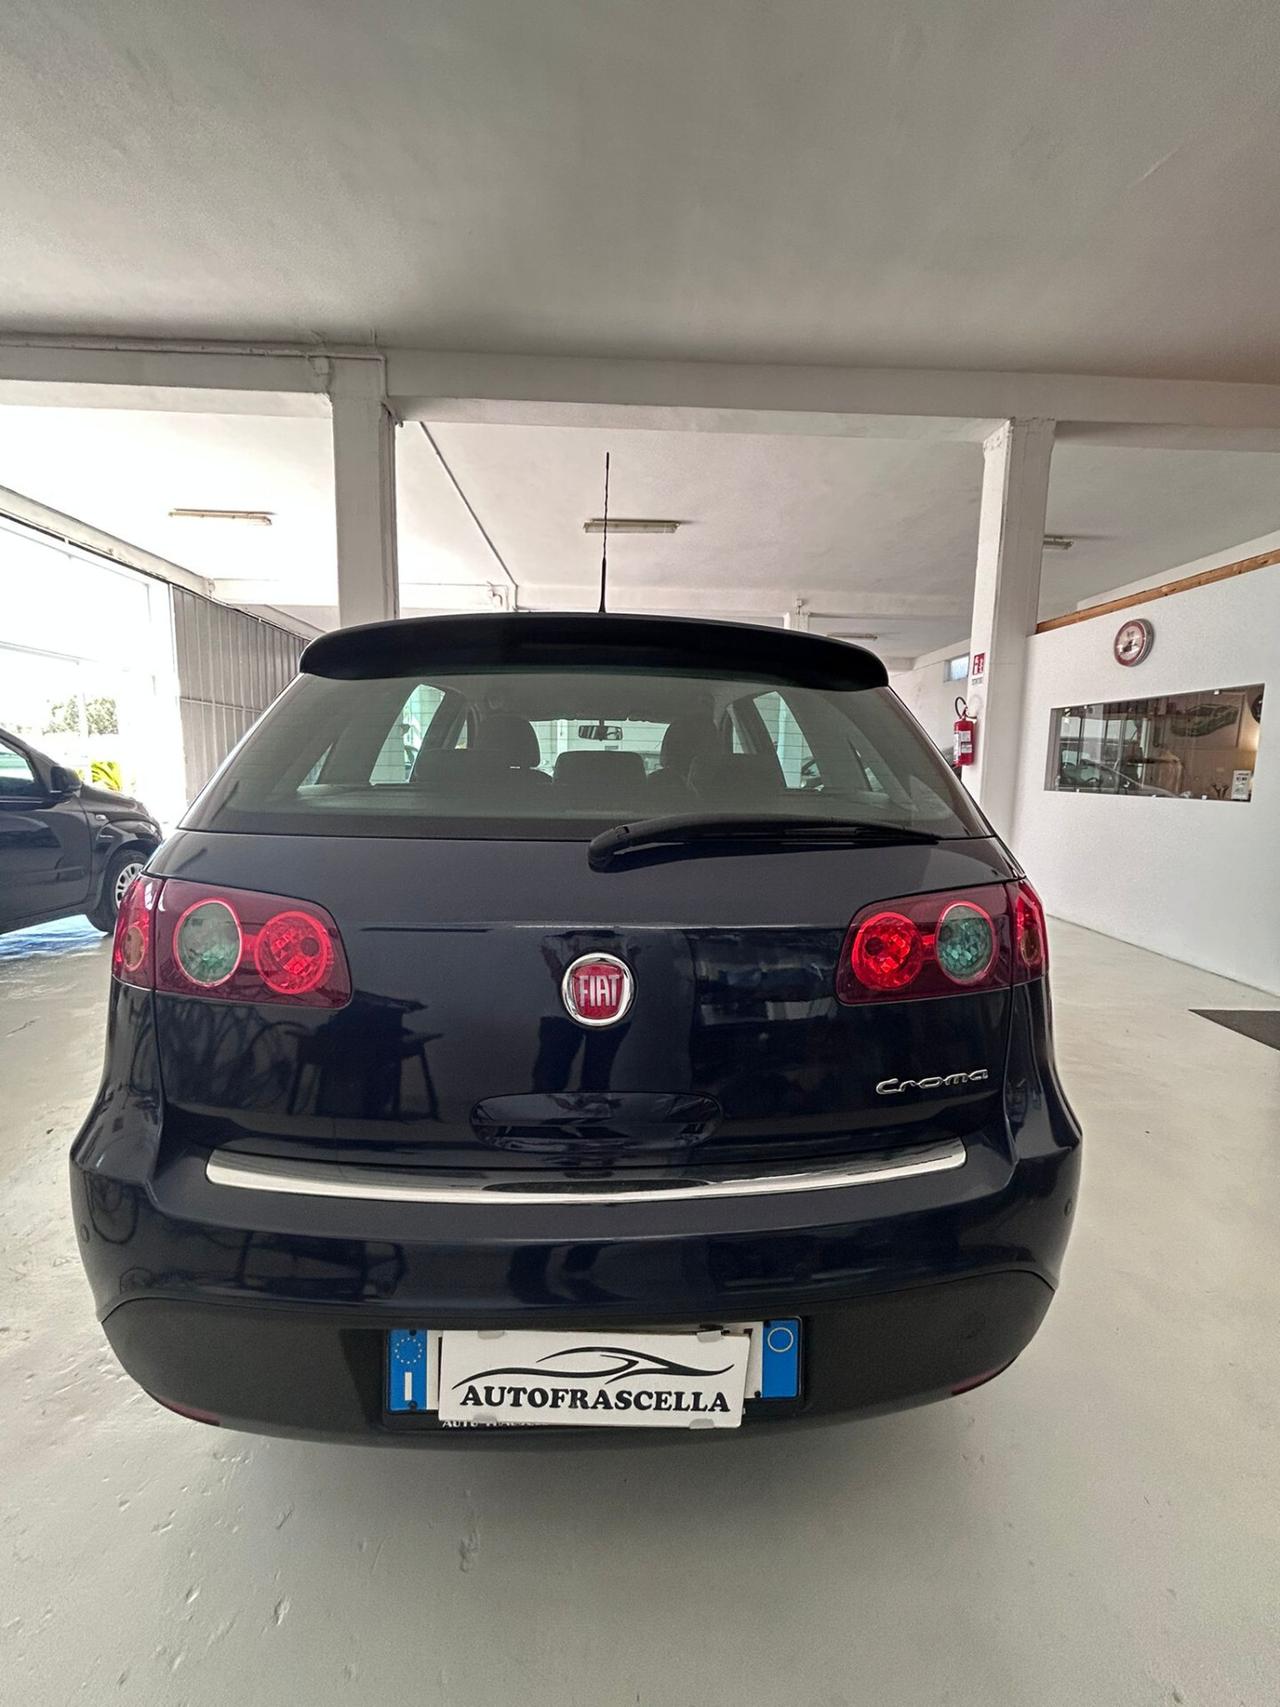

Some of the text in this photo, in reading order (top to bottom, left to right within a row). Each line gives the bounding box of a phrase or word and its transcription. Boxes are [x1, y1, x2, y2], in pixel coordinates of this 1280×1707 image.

[579, 974, 619, 1007] FIAT
[875, 1069, 988, 1095] Croma
[404, 1371, 413, 1401] I
[459, 1385, 731, 1413] AUTOFRASCELLA
